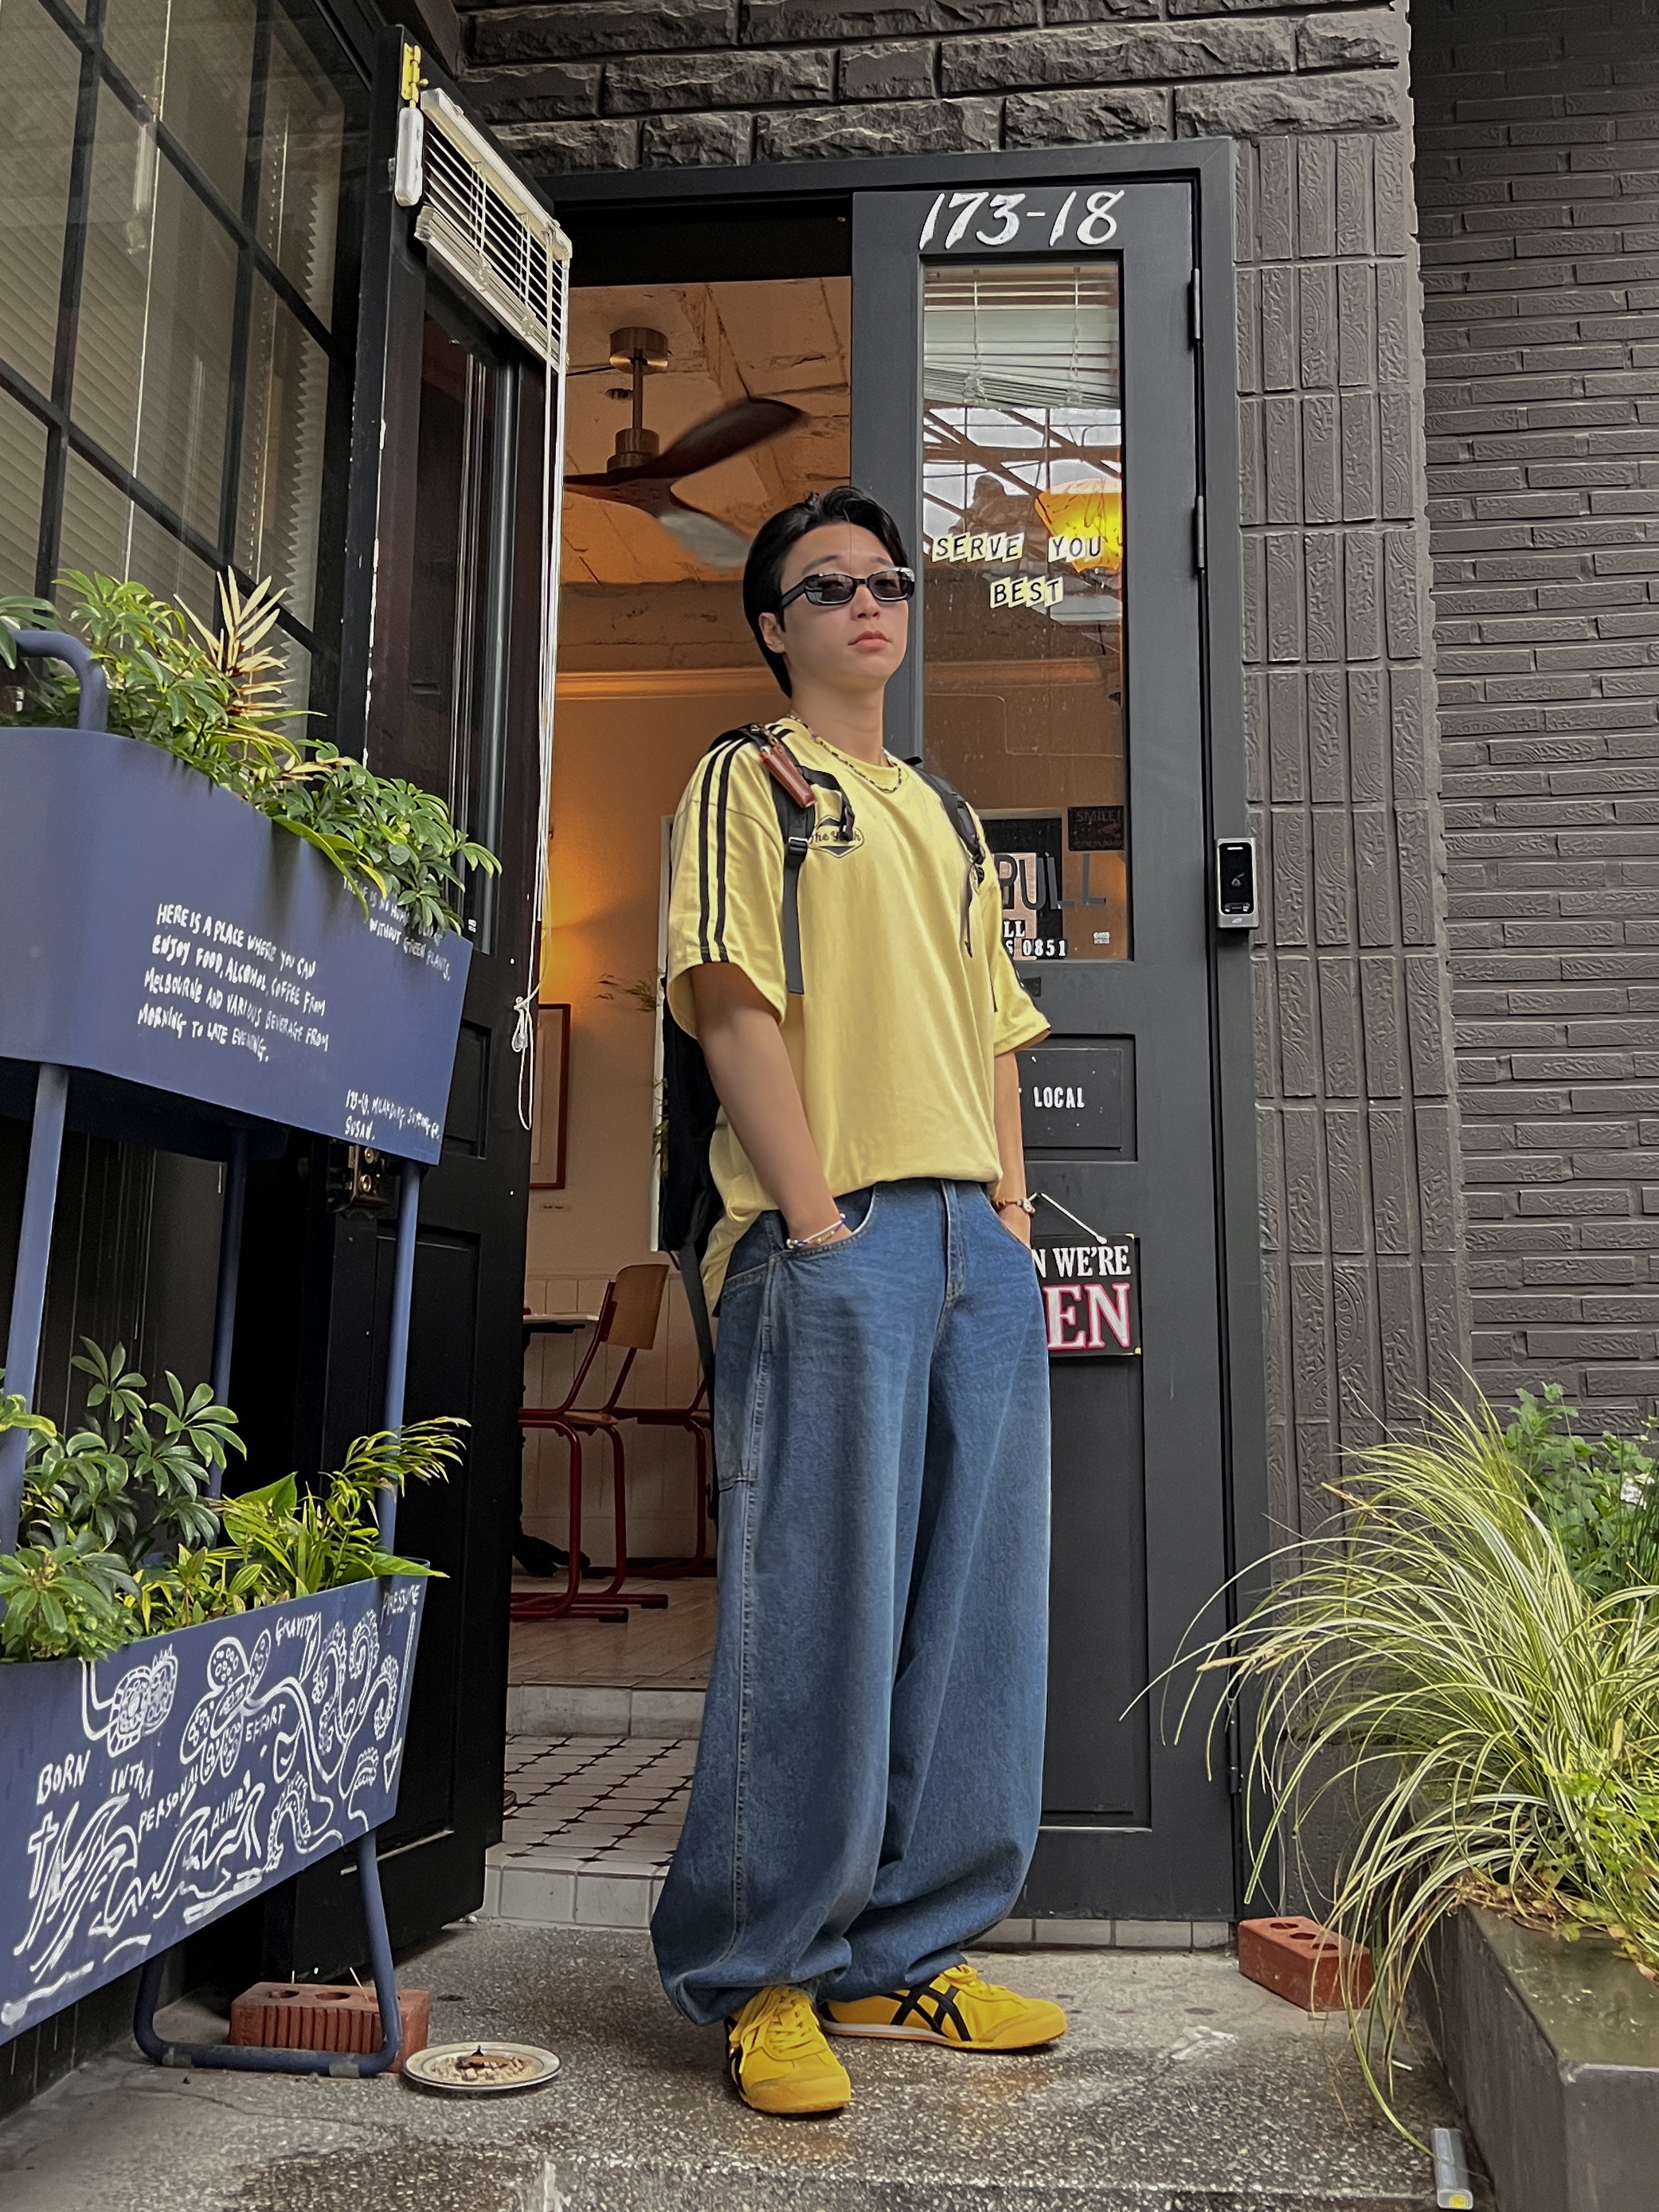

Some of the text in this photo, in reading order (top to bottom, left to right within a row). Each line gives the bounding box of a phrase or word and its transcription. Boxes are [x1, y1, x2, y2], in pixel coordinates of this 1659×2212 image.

[919, 190, 1125, 250] 173-18
[934, 534, 1102, 559] SERVE YOU
[993, 579, 1062, 605] BEST
[156, 903, 317, 980] HERE IS A PLACE WHERE YOU CAN
[370, 918, 402, 945] WITHOUT
[1023, 938, 1066, 957] 0851
[151, 934, 191, 966] ENJOY
[271, 977, 301, 1005] COFFEE
[303, 991, 326, 1016] FROM
[137, 1003, 187, 1039] MORNING
[207, 1022, 229, 1045] LATE
[144, 967, 329, 1052] MELBOURNE AND VARIOUS BEVERAGE FROM
[1032, 1086, 1086, 1109] LOCAL
[1052, 1245, 1131, 1278] WE'RE
[275, 1611, 322, 1646] GRAVITY
[37, 1749, 91, 1806] BORN
[111, 1760, 154, 1799] INTRA
[138, 1763, 199, 1843] PERSONAL
